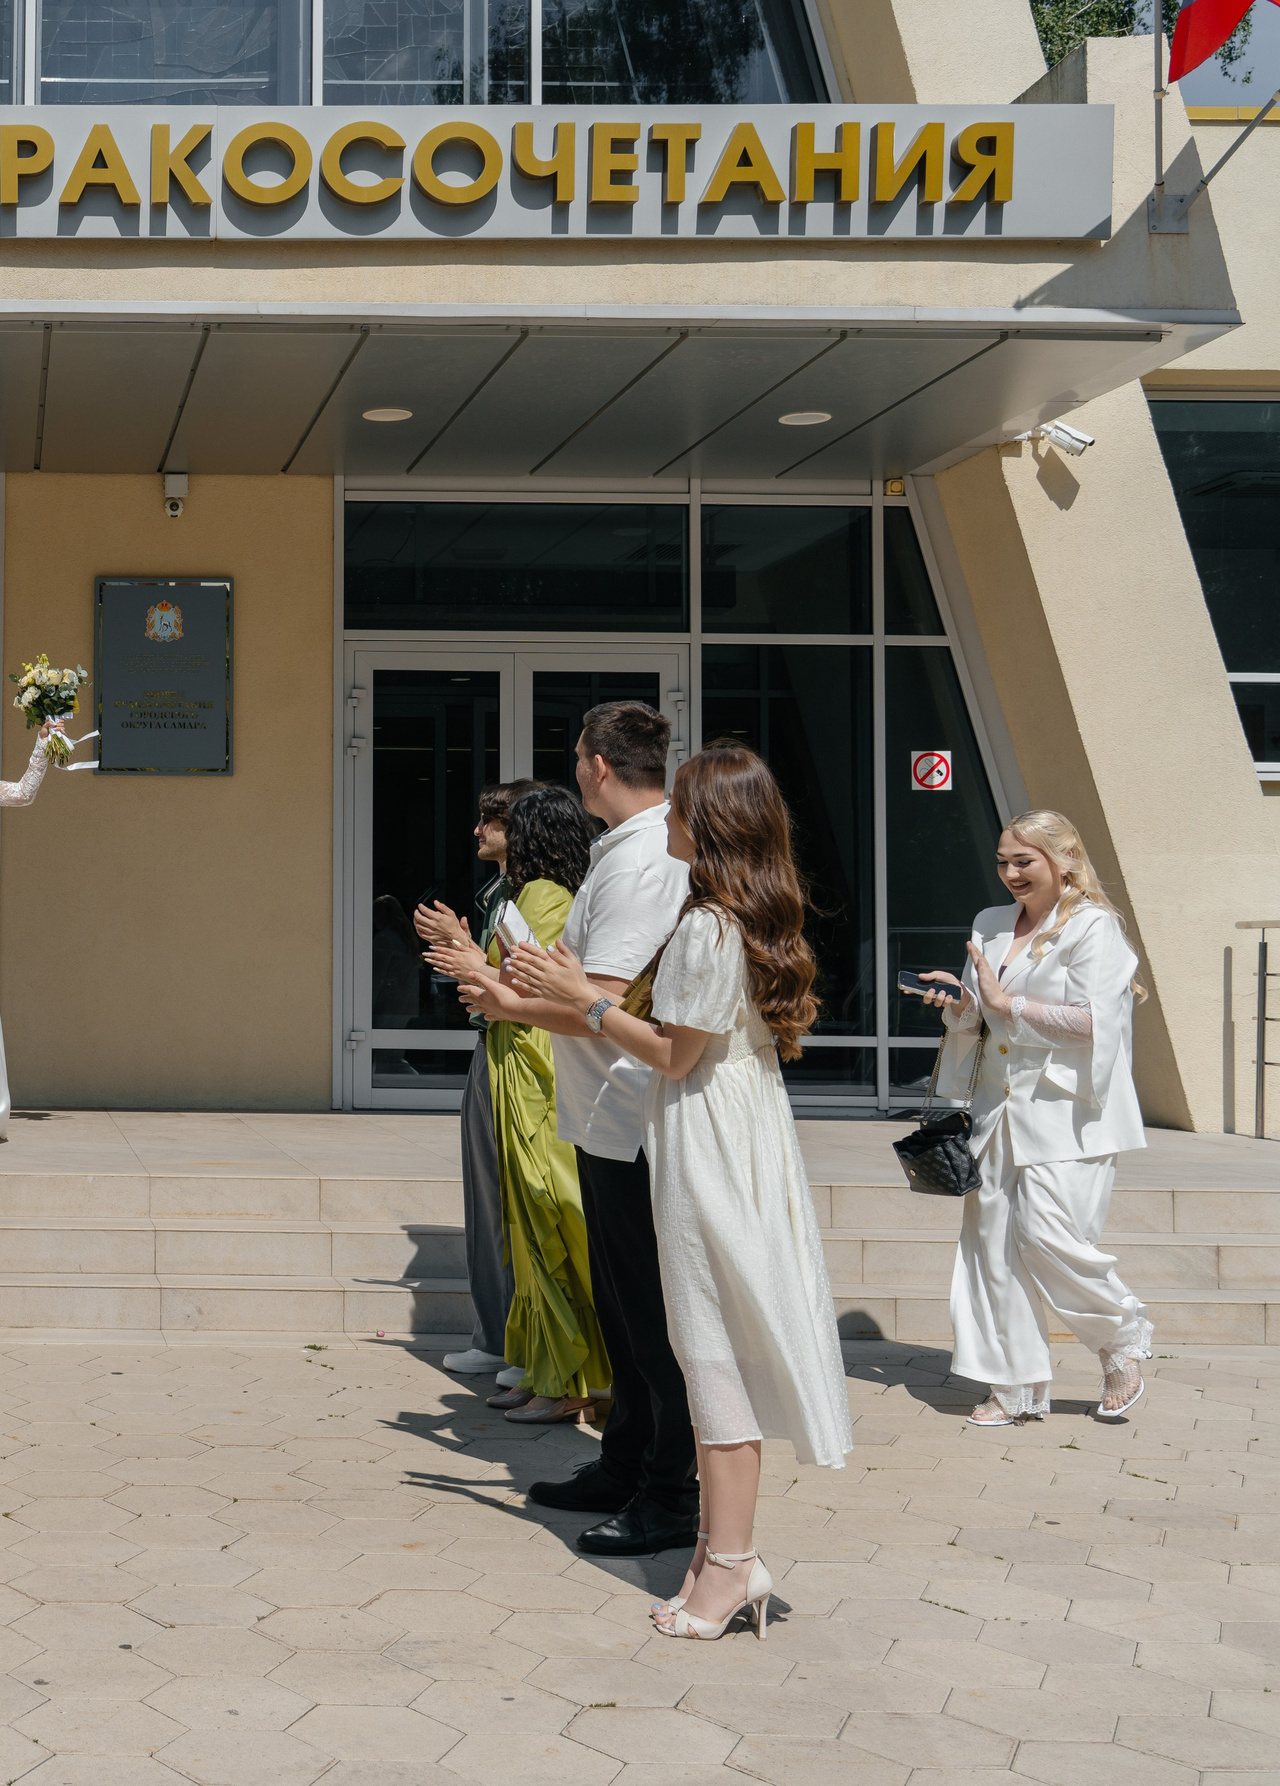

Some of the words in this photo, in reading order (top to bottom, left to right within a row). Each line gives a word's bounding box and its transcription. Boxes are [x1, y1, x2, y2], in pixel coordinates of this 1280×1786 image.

[130, 711, 198, 719] ГОРОДСКОГО
[121, 721, 161, 729] ОКРУГА
[163, 721, 207, 729] САМАРА
